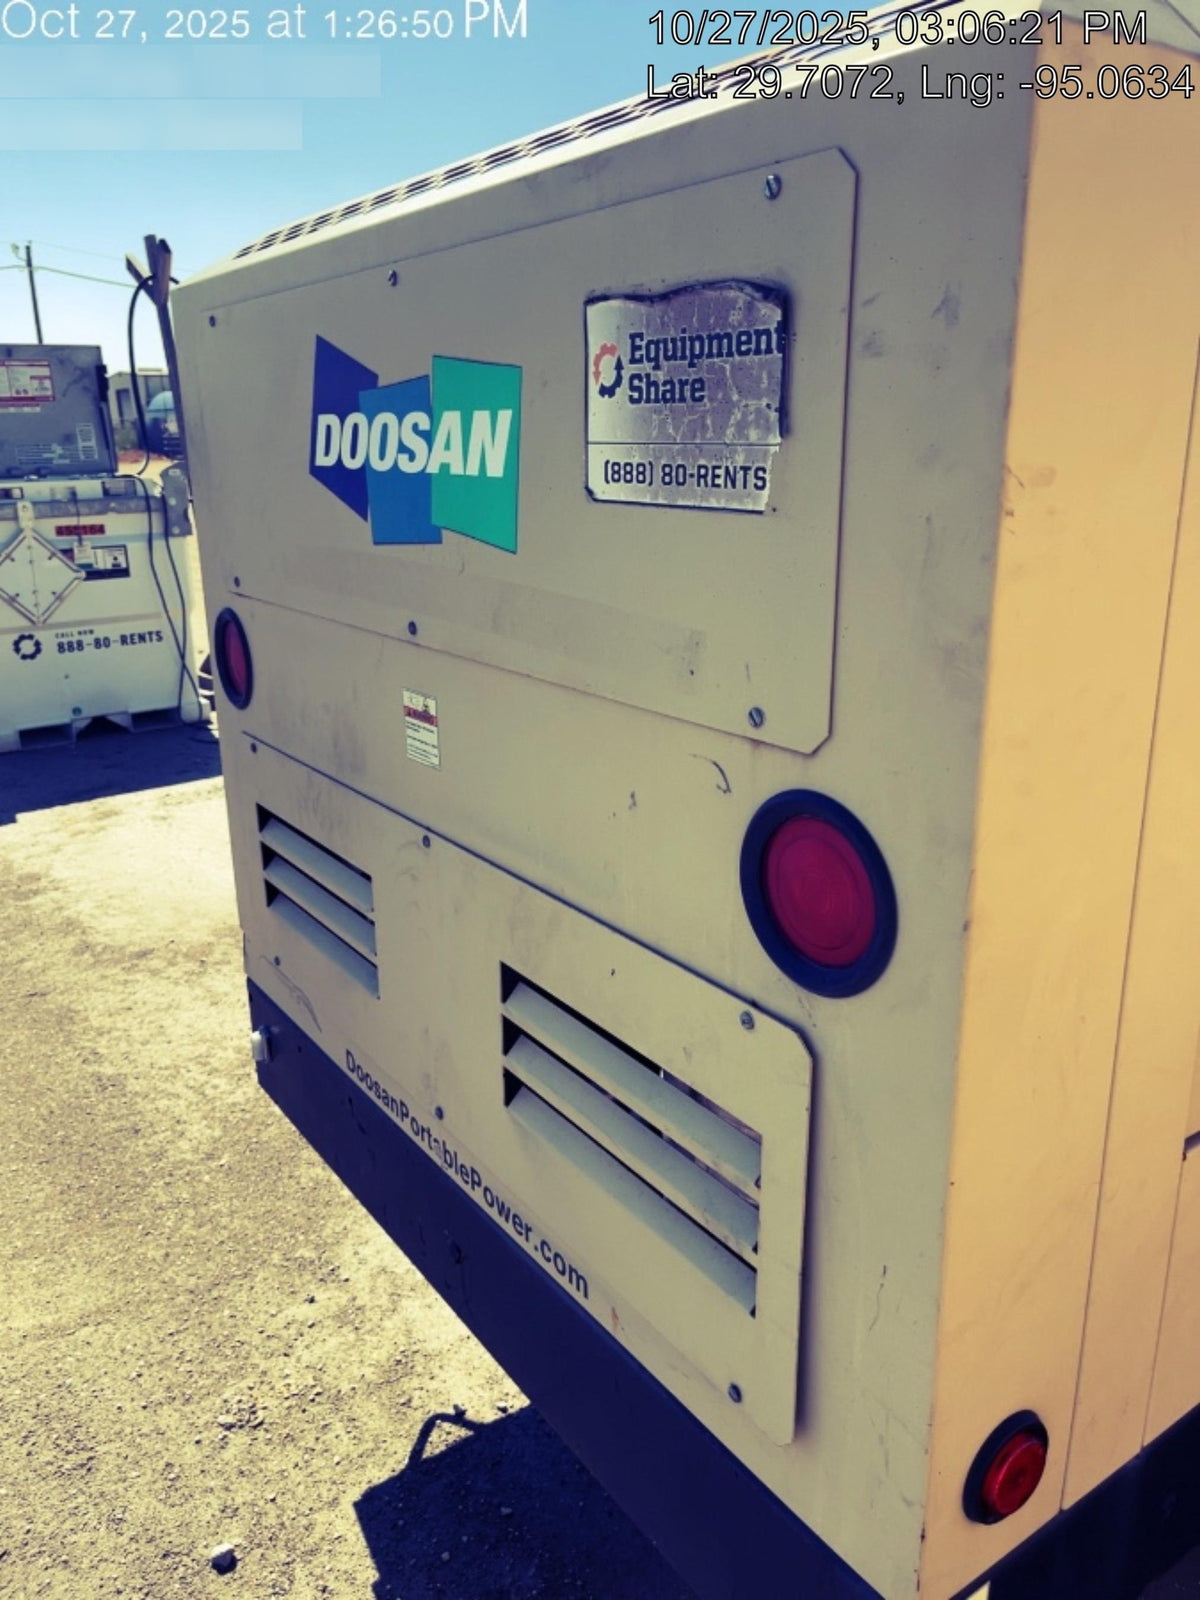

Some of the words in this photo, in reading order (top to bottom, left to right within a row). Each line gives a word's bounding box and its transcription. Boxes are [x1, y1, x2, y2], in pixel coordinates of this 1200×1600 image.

[628, 320, 787, 370] Equipment
[628, 372, 706, 405] Share
[314, 408, 513, 478] DOOSAN
[604, 459, 654, 486] (888)
[661, 463, 767, 491] 80-RENTS
[57, 630, 164, 654] 888-80-RENTS
